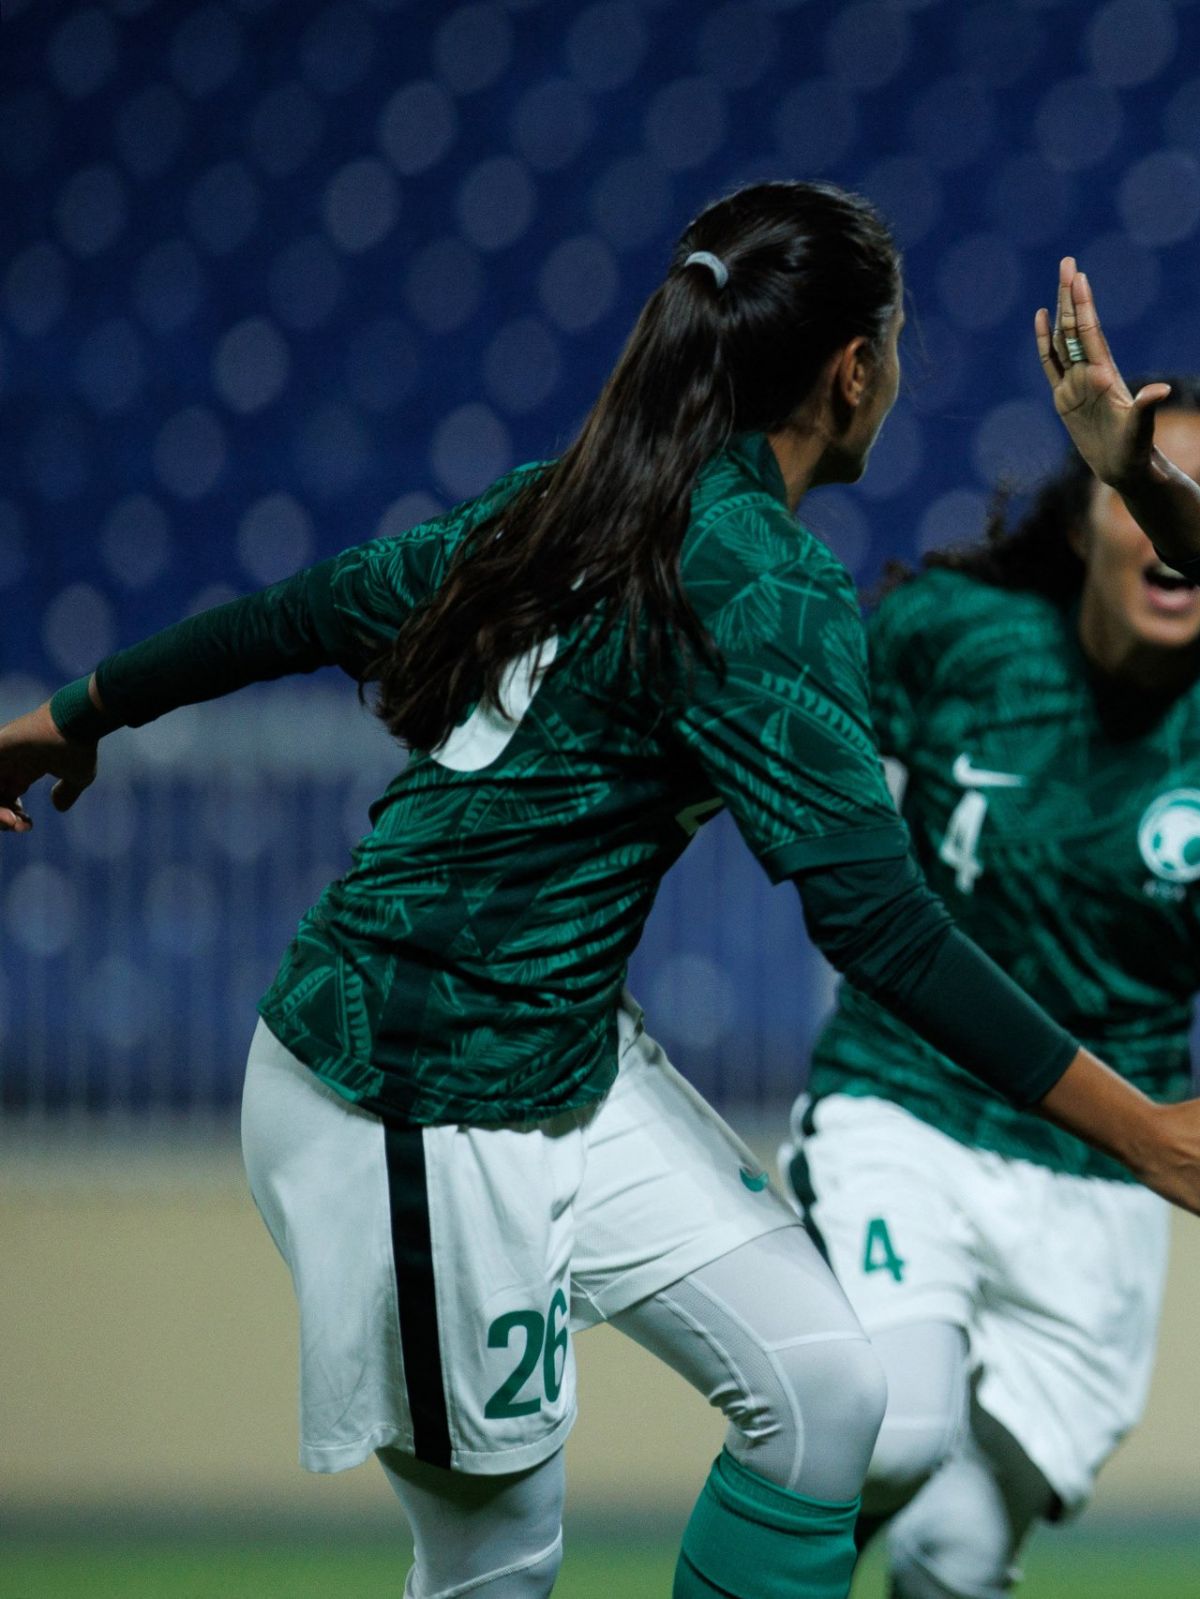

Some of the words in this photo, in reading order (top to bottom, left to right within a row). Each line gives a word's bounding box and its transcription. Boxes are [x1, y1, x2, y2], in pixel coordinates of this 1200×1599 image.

[939, 790, 987, 894] 4
[864, 1217, 905, 1283] 4
[484, 1287, 568, 1419] 26
